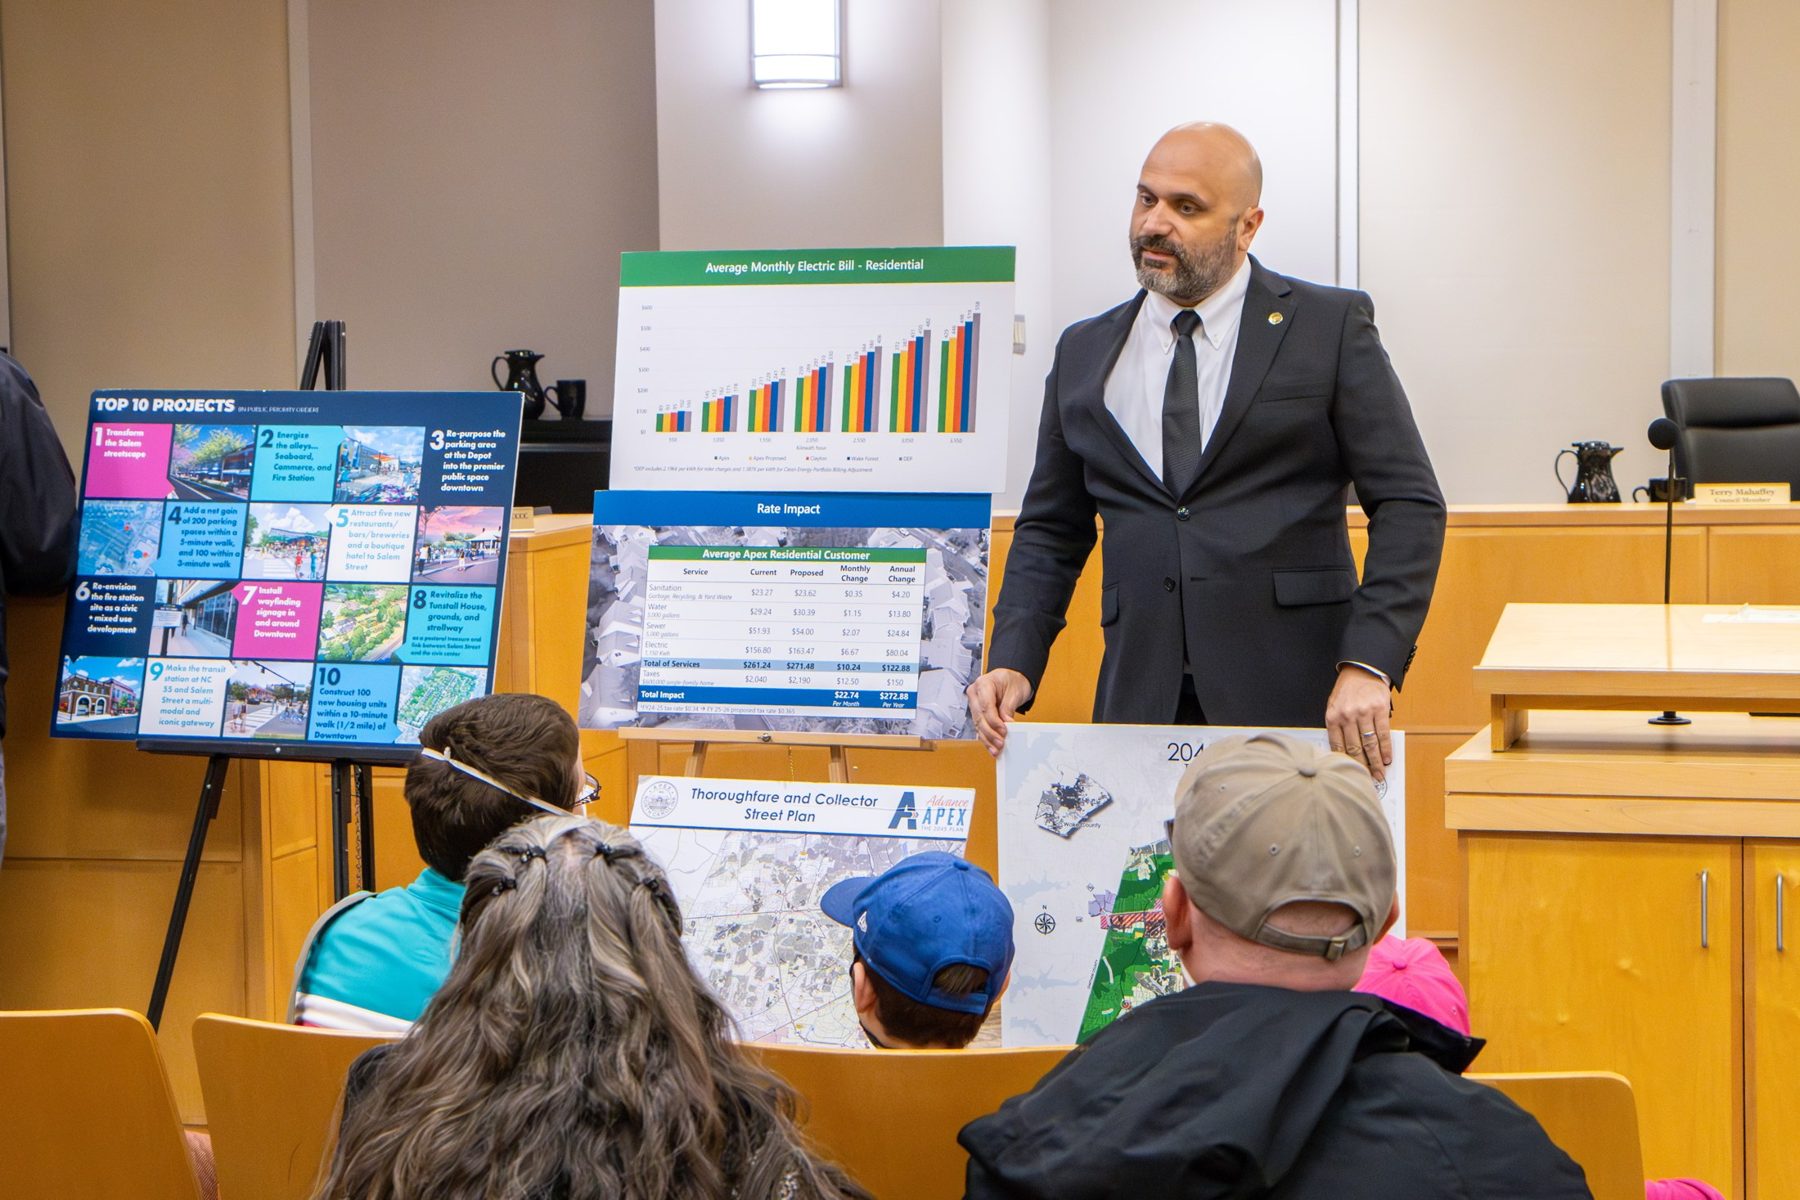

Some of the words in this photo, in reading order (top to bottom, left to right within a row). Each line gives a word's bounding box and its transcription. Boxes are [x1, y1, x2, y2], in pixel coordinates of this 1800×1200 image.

[705, 262, 748, 275] Average
[751, 261, 795, 274] Monthly
[797, 260, 835, 272] Electric
[838, 260, 854, 271] Bill
[865, 259, 924, 271] Residential
[96, 397, 129, 411] TOP
[132, 398, 149, 412] 10
[152, 398, 235, 412] PROJECTS
[95, 427, 103, 446] 1
[106, 428, 145, 437] Transform
[261, 429, 274, 448] 2
[277, 431, 309, 440] Energize
[429, 430, 445, 450] 3
[446, 430, 491, 439] Re-purpose
[118, 439, 142, 447] Salem
[445, 441, 476, 450] parking
[104, 450, 146, 459] streetscape
[275, 452, 314, 461] Seaboard,
[468, 452, 492, 461] Depot
[274, 463, 315, 472] Commerce,
[317, 463, 332, 471] and
[443, 462, 458, 470] into
[473, 463, 505, 471] premier
[442, 473, 465, 482] public
[466, 474, 489, 482] space
[440, 484, 484, 492] downtown
[1736, 488, 1775, 496] Mahaffey
[757, 503, 781, 514] Rate
[783, 504, 820, 516] Impact
[168, 506, 181, 525] 4
[221, 507, 238, 516] gain
[336, 508, 349, 528] 5
[207, 518, 237, 527] parking
[350, 520, 398, 528] restaurants/
[181, 529, 206, 537] spaces
[208, 528, 231, 536] within
[180, 538, 213, 546] 5-minute
[214, 539, 235, 547] walk,
[371, 542, 405, 551] boutique
[702, 549, 741, 560] Average
[743, 550, 768, 560] Apex
[770, 550, 821, 560] Residential
[824, 551, 870, 560] Customer
[212, 560, 231, 568] walk
[790, 569, 824, 578] Proposed
[840, 565, 871, 573] Monthly
[889, 565, 916, 573] Annual
[841, 575, 869, 583] Change
[888, 576, 916, 584] Change
[75, 581, 91, 601] 6
[92, 582, 136, 590] Re-envision
[241, 585, 258, 605] 7
[259, 586, 283, 595] Install
[751, 588, 773, 596] $23.27
[794, 589, 817, 597] $23.62
[844, 590, 863, 598] $0.35
[118, 594, 144, 602] station
[258, 597, 301, 607] wayfinding
[413, 590, 427, 609] 8
[430, 591, 468, 599] Revitalize
[121, 604, 138, 612] civic
[429, 602, 458, 610] Tunstall
[460, 602, 487, 611] House,
[256, 608, 287, 617] signage
[750, 608, 772, 616] $29.24
[793, 609, 815, 617] $30.39
[843, 609, 862, 617] $1.15
[888, 610, 911, 618] $13.80
[94, 614, 118, 622] mixed
[428, 613, 462, 622] grounds,
[464, 613, 480, 621] and
[255, 619, 271, 627] and
[271, 619, 300, 627] around
[87, 625, 136, 634] development
[427, 624, 463, 633] strollway
[748, 627, 770, 635] $51.93
[792, 627, 814, 636] $54.00
[842, 628, 860, 637] $2.07
[887, 629, 910, 637] $24.84
[254, 630, 296, 638] Downtown
[645, 641, 668, 649] Electric
[745, 646, 772, 654] $156.80
[788, 647, 815, 655] $163.47
[841, 648, 859, 656] $6.67
[886, 649, 909, 657] $80.04
[671, 660, 700, 668] Services
[743, 661, 771, 669] $261.24
[786, 662, 815, 670] $271.48
[837, 663, 861, 671] $10.24
[882, 664, 911, 672] $122.88
[150, 662, 164, 681] 9
[166, 664, 187, 672] Make
[202, 665, 226, 673] transit
[319, 667, 341, 686] 10
[836, 677, 859, 685] $12.50
[887, 679, 904, 687] $150
[190, 686, 214, 694] Salem
[320, 688, 355, 696] Construct
[641, 690, 659, 698] Total
[660, 691, 685, 700] Impact
[834, 691, 859, 699] $22.74
[880, 692, 909, 700] $272.88
[336, 699, 367, 709] housing
[368, 700, 387, 708] units
[186, 708, 201, 716] and
[317, 709, 341, 717] within
[350, 711, 388, 719] 10-minute
[180, 720, 215, 729] gateway
[315, 720, 335, 728] walk
[336, 721, 355, 730] (1/2
[356, 721, 376, 730] mile)
[314, 731, 357, 740] Downtown
[691, 788, 780, 804] Thoroughfare
[784, 793, 811, 804] and
[815, 793, 878, 807] Collector
[926, 795, 969, 807] Advance
[745, 808, 783, 821] Street
[787, 810, 816, 822] Plan
[922, 806, 967, 826] APEX
